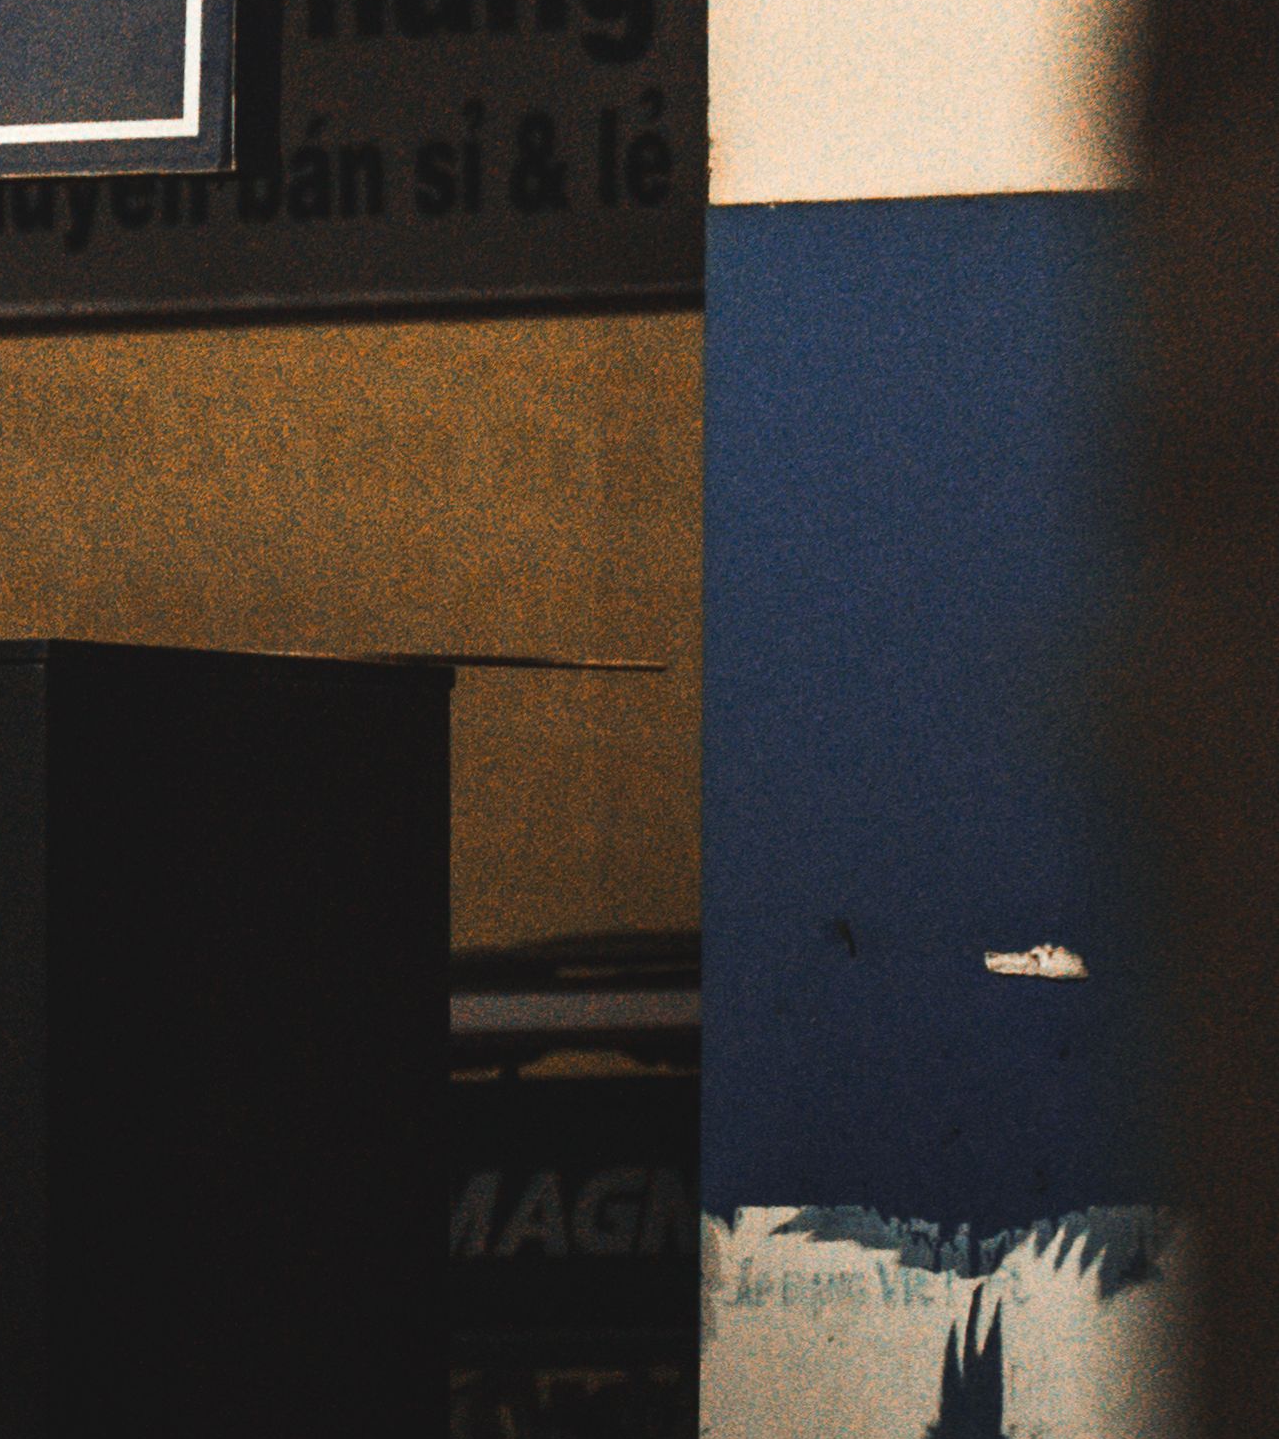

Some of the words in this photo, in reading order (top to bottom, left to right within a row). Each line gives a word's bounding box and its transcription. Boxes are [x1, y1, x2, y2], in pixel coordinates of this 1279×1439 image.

[415, 97, 485, 216] sỉ
[509, 111, 570, 214] &
[597, 87, 673, 207] lẻ
